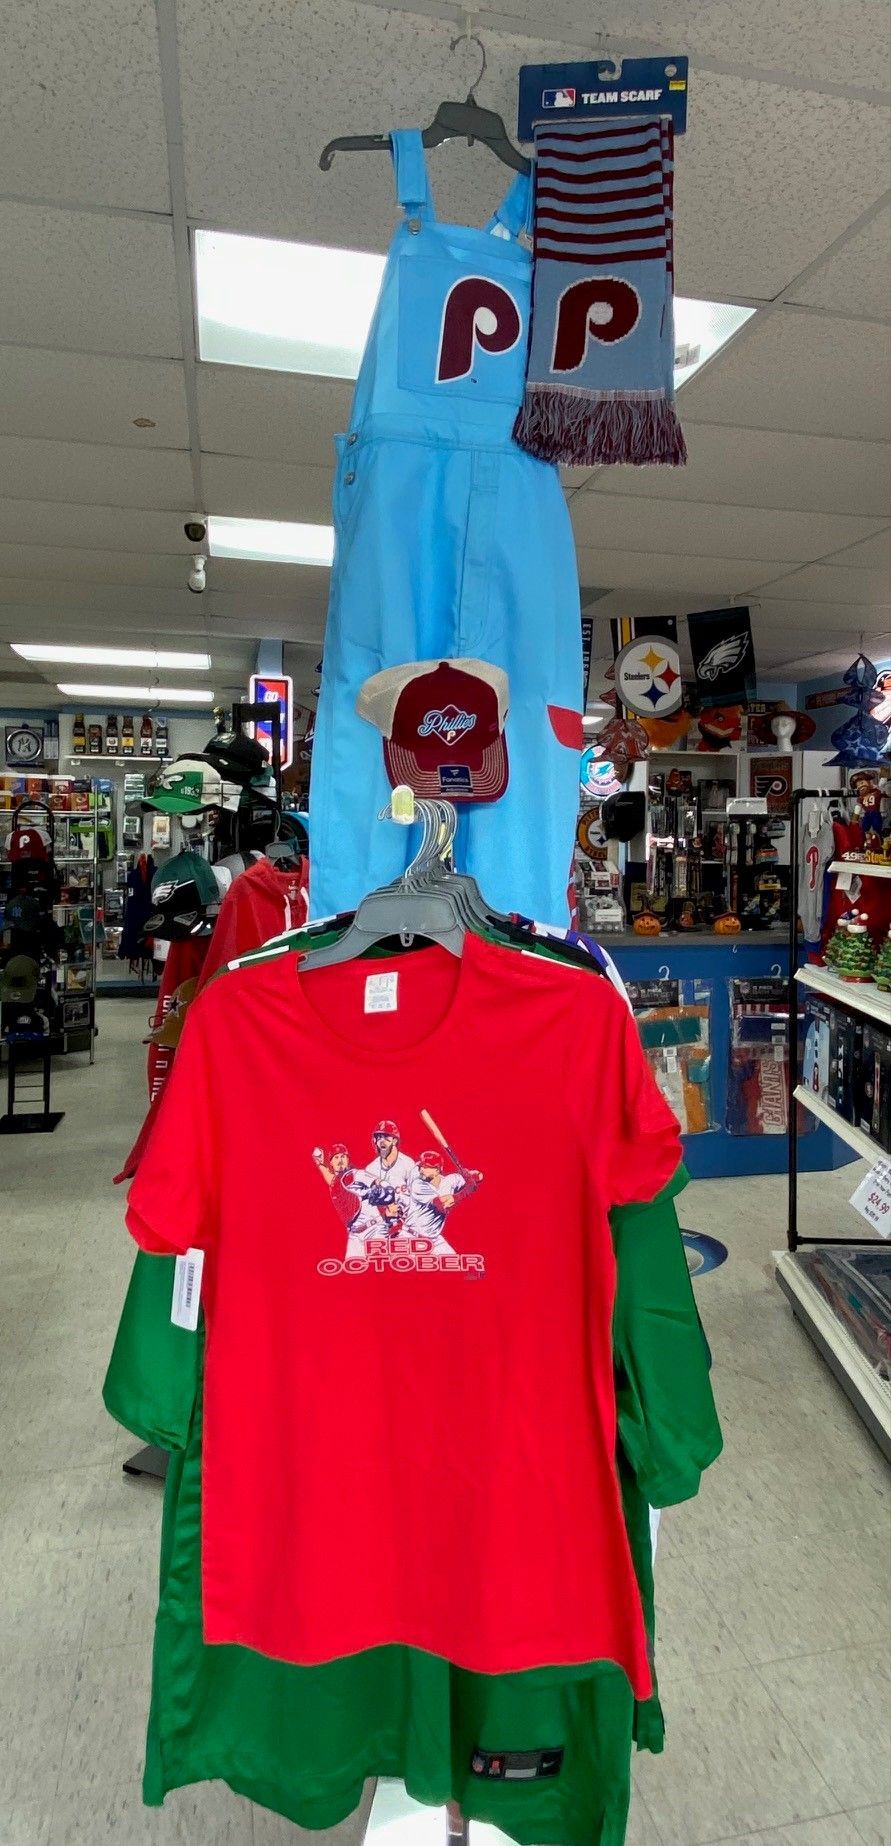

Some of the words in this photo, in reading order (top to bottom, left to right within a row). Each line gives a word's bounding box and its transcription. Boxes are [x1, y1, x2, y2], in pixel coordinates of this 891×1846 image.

[582, 91, 618, 105] TEAM
[620, 88, 663, 102] SCARF
[435, 275, 523, 385] P
[550, 276, 643, 373] P
[623, 671, 651, 682] Steelers
[417, 709, 477, 737] Phillies
[862, 795, 875, 806] 49
[762, 1059, 786, 1128] GIANTS
[867, 1191, 890, 1215] $24.99
[365, 1238, 433, 1255] RED
[316, 1253, 486, 1277] OCTOBER
